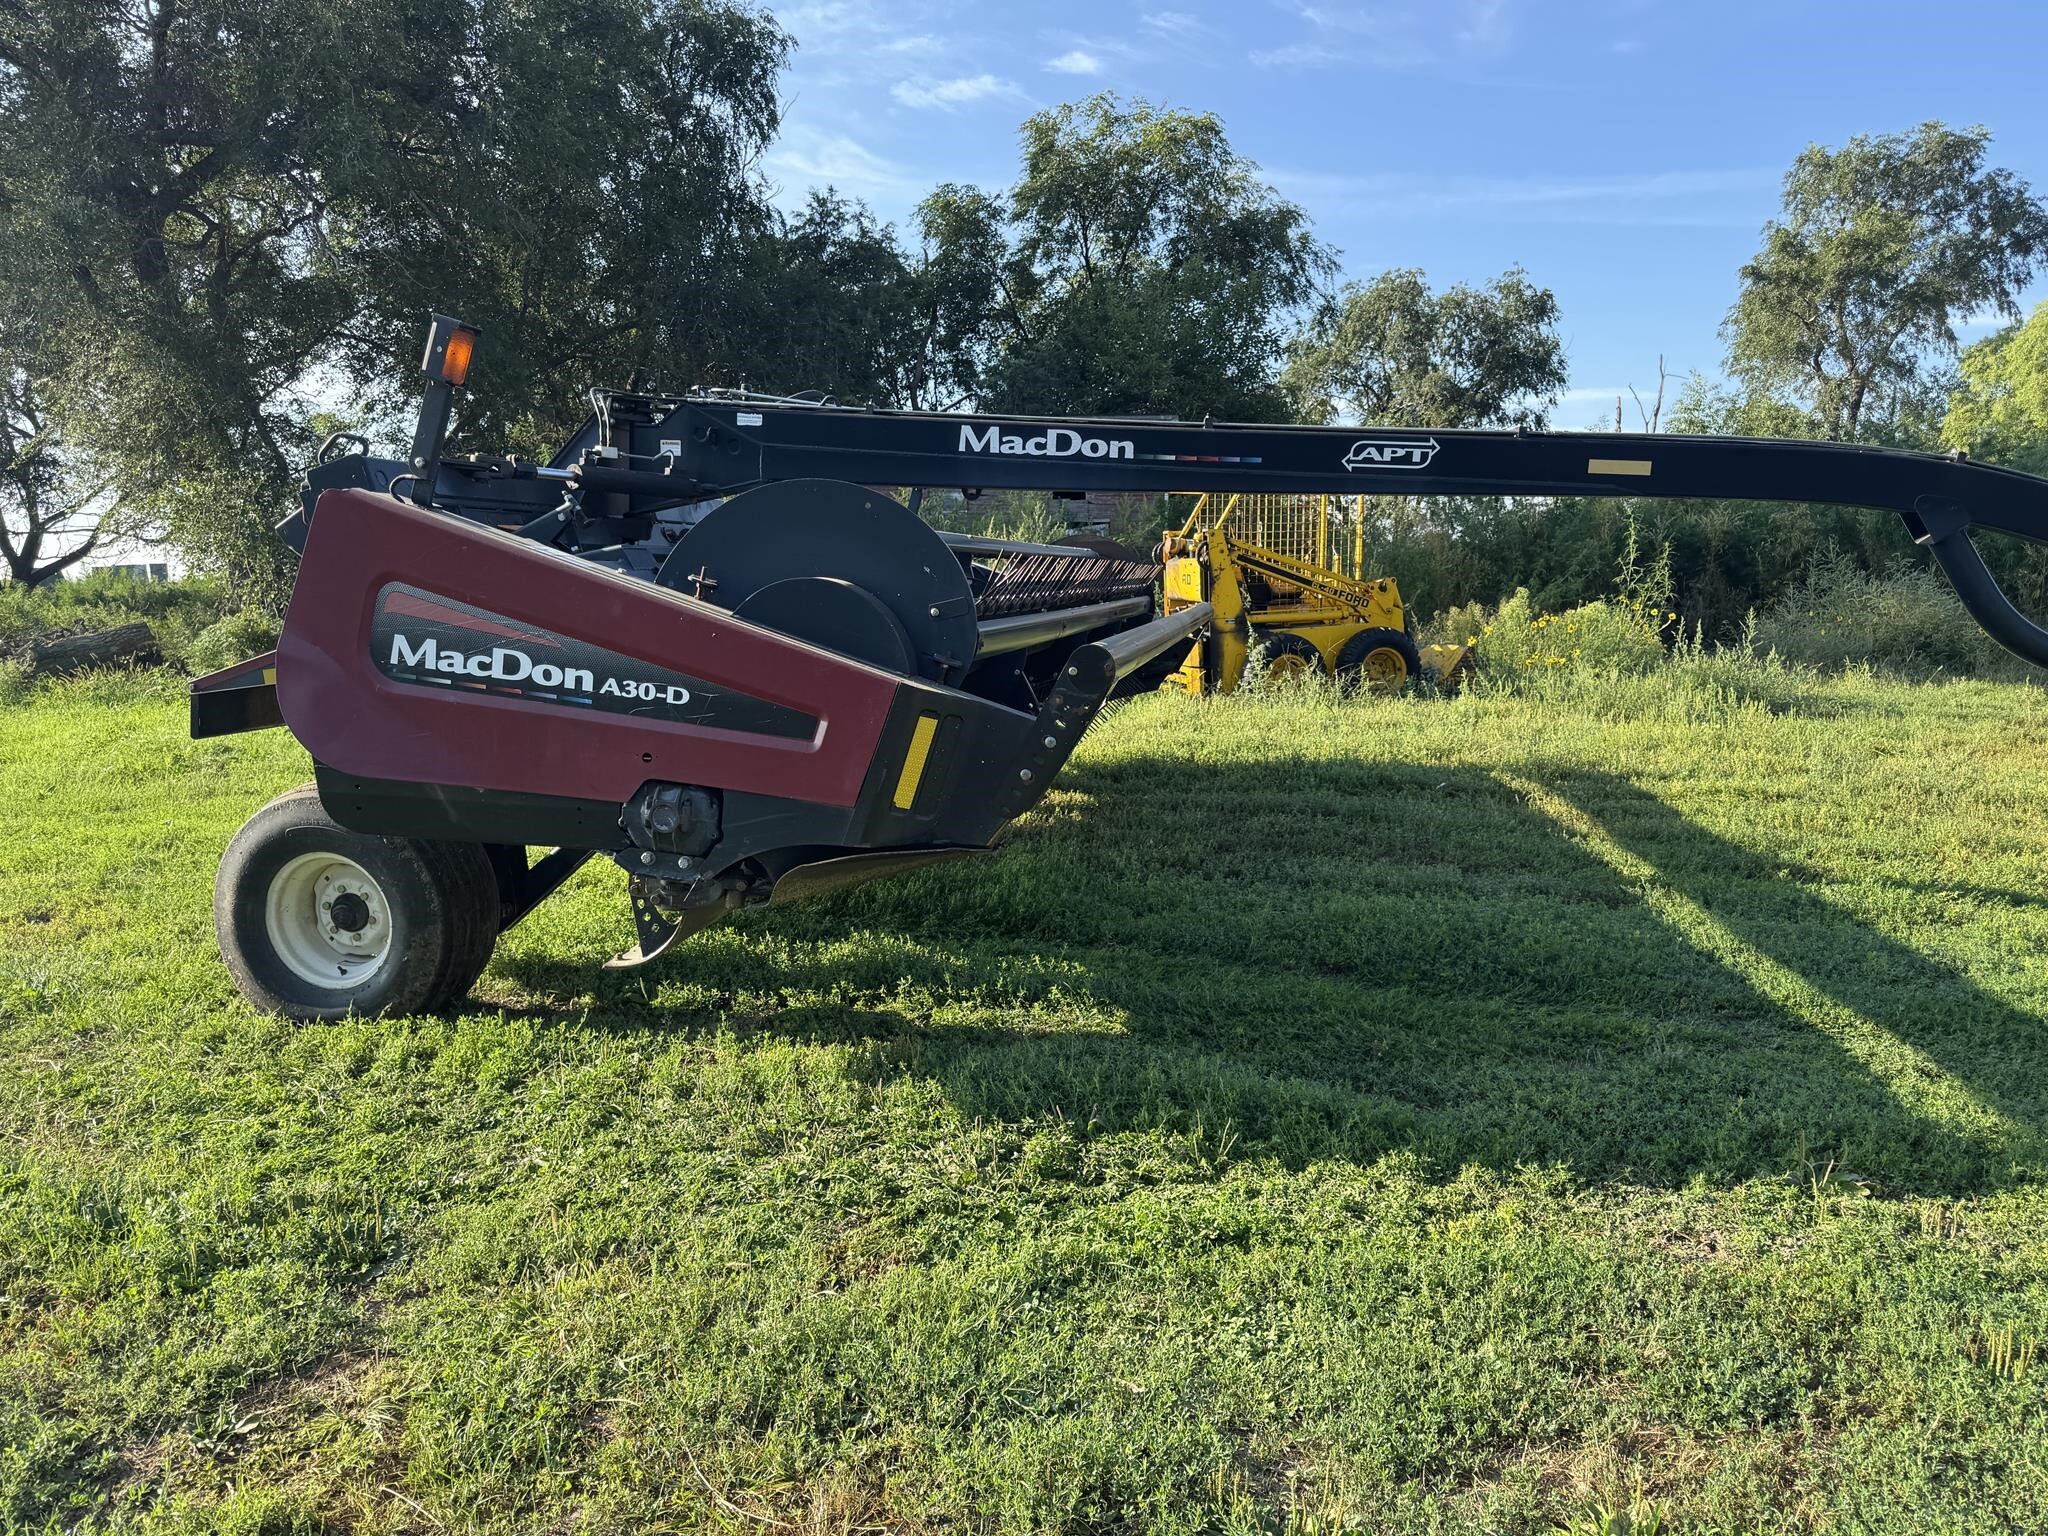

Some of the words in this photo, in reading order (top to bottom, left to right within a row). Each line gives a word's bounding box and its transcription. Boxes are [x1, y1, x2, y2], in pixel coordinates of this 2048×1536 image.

[958, 425, 1134, 459] MacDon
[1350, 446, 1431, 463] APT
[1337, 590, 1370, 608] FORD
[389, 634, 594, 692] MacDon
[599, 678, 690, 705] A30-D
